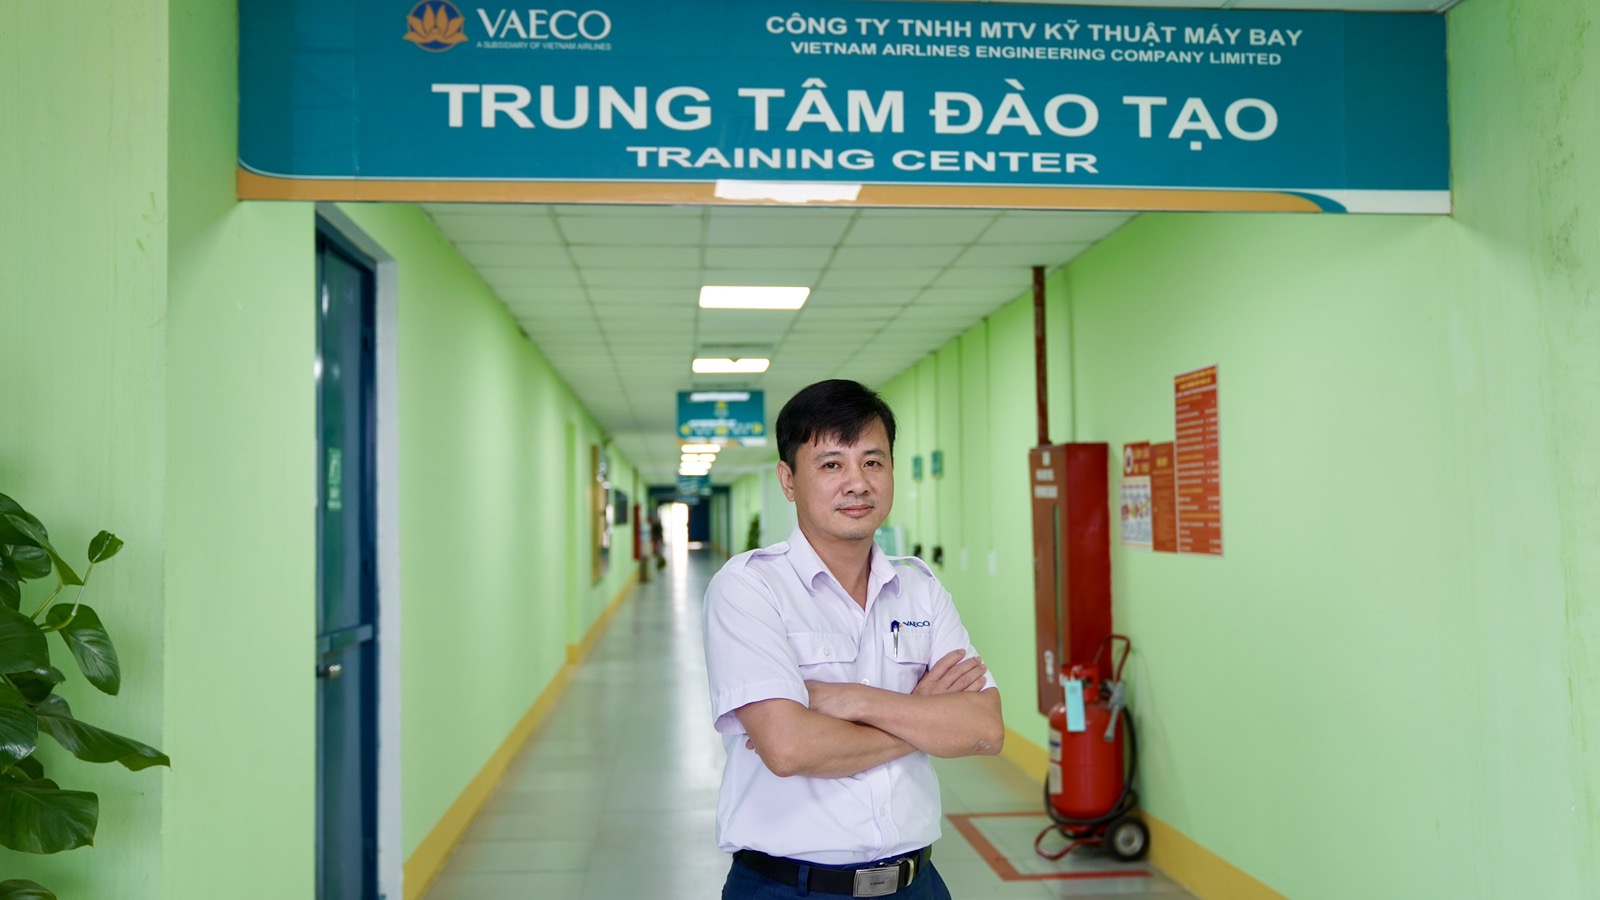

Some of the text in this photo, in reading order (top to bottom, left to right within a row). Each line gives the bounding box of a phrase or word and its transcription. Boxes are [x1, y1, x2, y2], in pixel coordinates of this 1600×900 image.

[477, 8, 612, 41] VAECO
[766, 12, 1303, 47] CÔNG TY TNHH MTV KỸ THUẬT MÁY BAY
[542, 42, 576, 50] VIETNAM
[577, 43, 612, 51] AIRLINES
[790, 41, 1282, 66] VIETNAM AIRLINES ENGINEERING COMPANY LIMITED
[431, 77, 1278, 151] TRUNG TÂM ĐÀO TẠO
[626, 146, 1098, 174] TRAINING CENTER
[902, 620, 930, 628] VAECO
